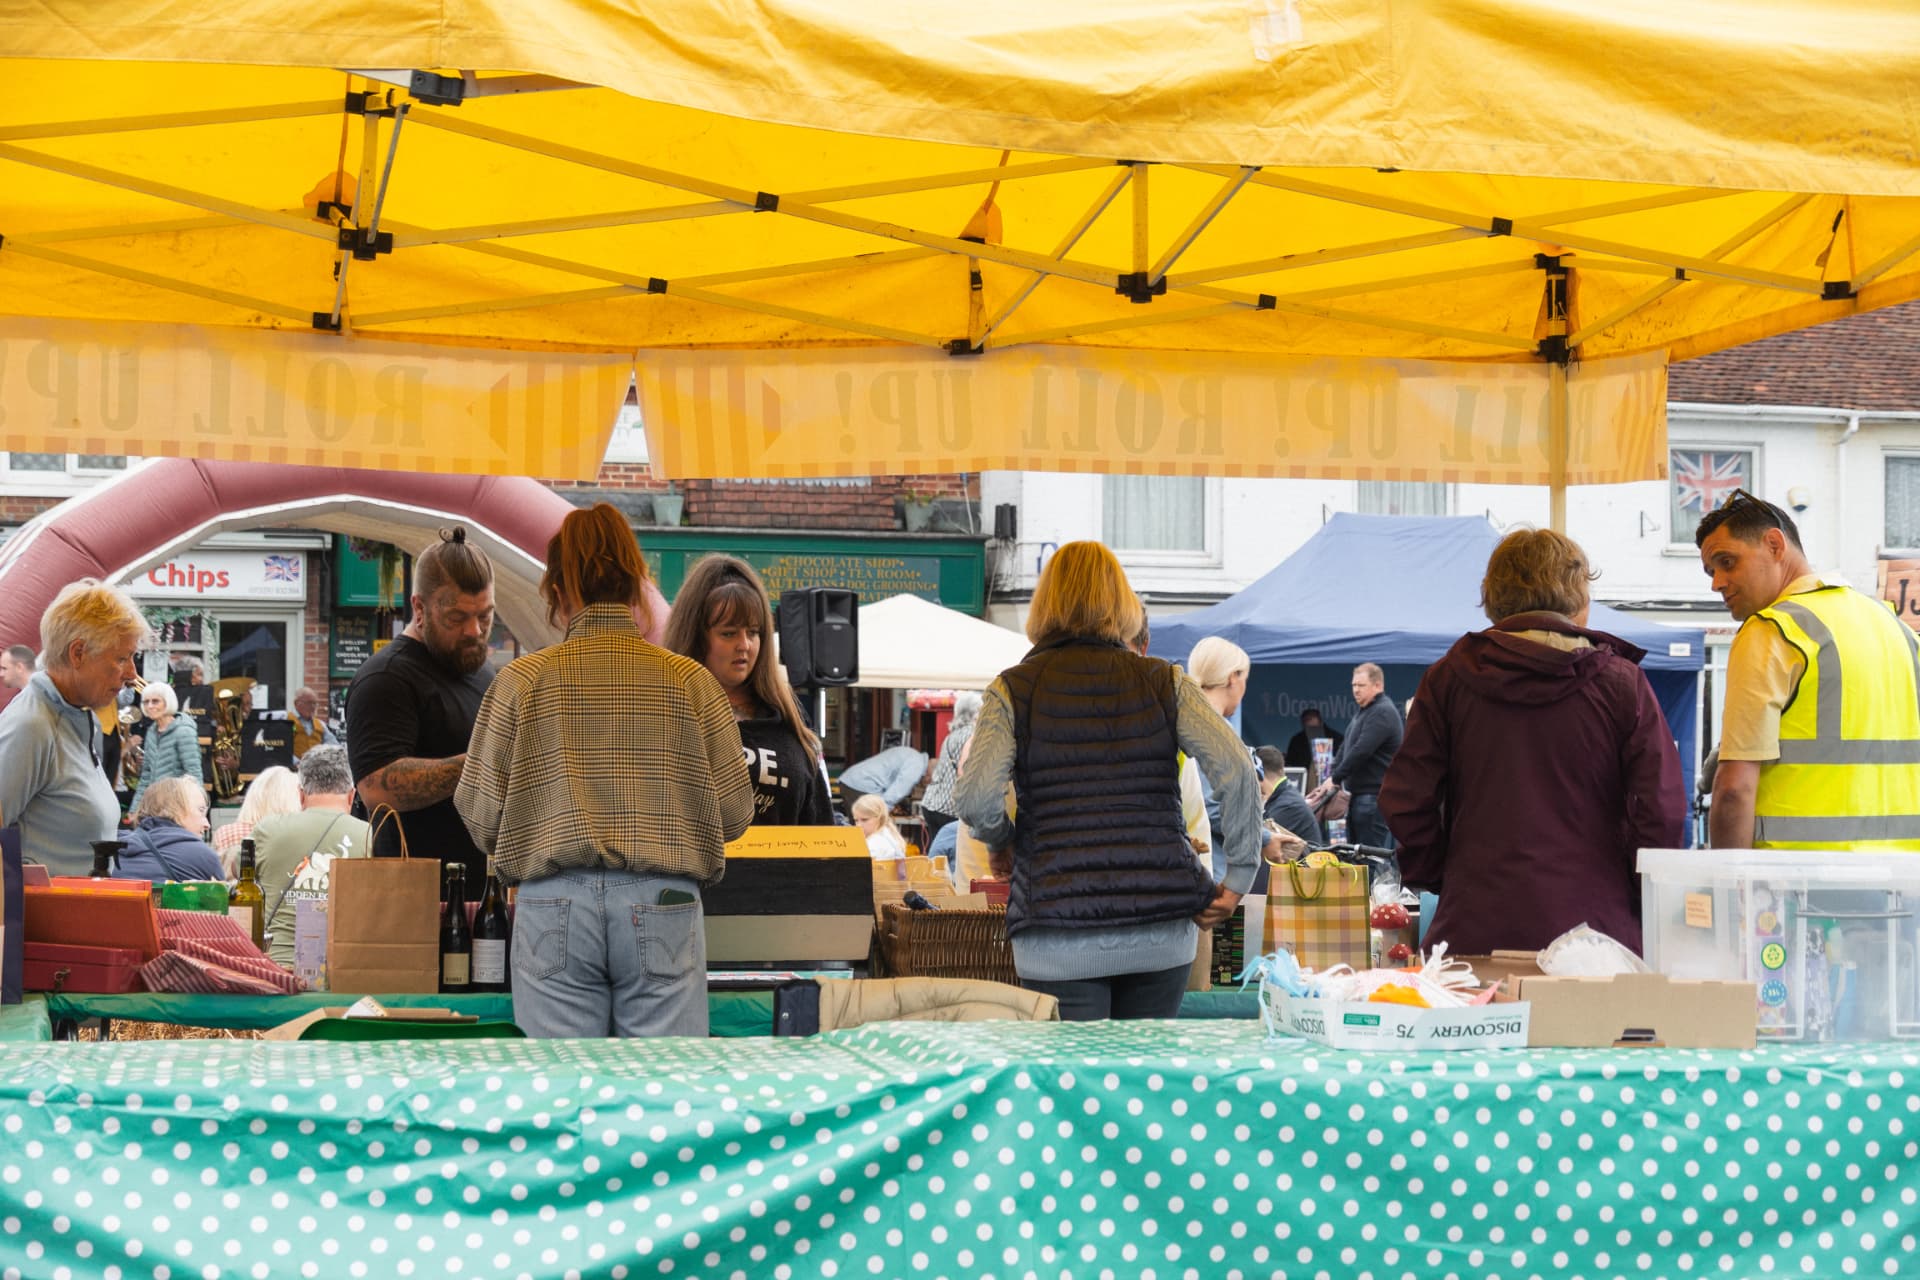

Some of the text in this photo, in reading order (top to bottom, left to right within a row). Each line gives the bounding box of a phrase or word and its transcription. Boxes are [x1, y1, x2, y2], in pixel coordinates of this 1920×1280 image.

[786, 556, 899, 569] CHOCOLATE SHOP
[148, 563, 230, 593] Chips
[767, 567, 916, 580] GIFT SHOP TEA ROOM
[846, 580, 872, 591] DOG
[873, 581, 932, 593] GROOMING
[742, 747, 789, 788] PE.
[1396, 1021, 1522, 1039] DISCOVERY 75
